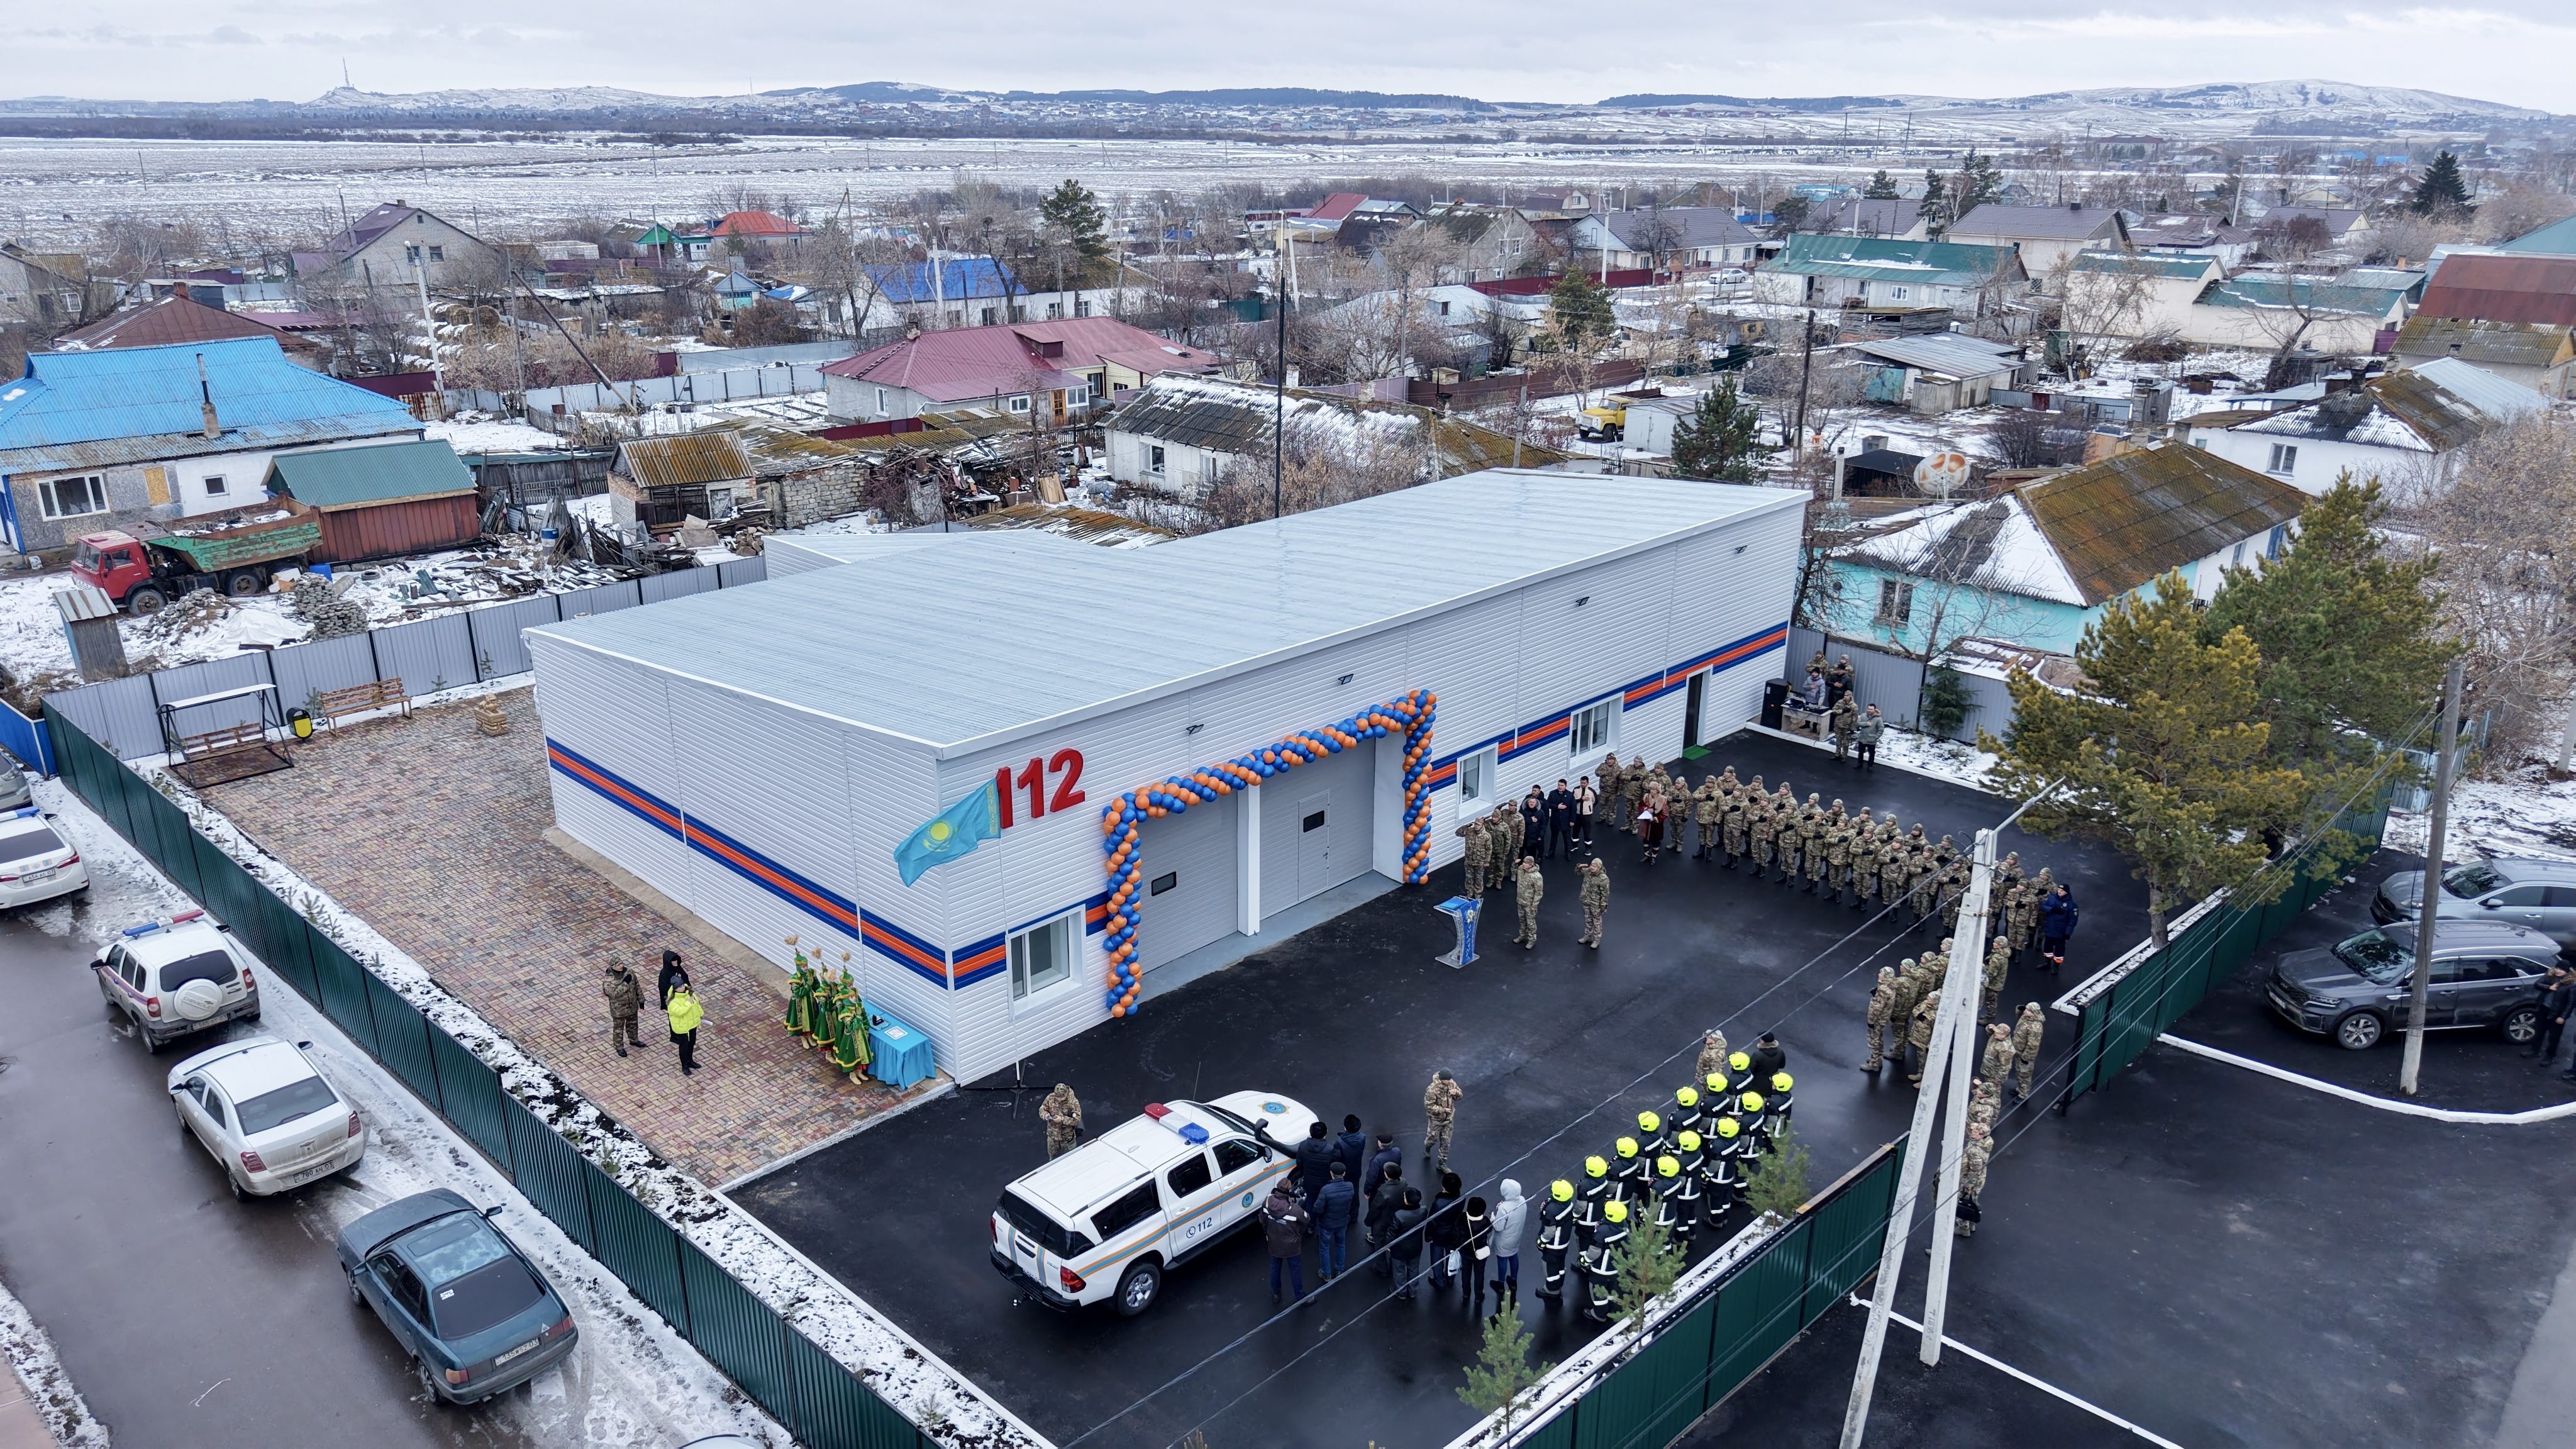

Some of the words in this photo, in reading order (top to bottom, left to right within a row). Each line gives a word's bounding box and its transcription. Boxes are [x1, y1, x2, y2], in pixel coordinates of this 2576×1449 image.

[996, 748, 1085, 829] 112
[1197, 1217, 1213, 1232] 112
[529, 1340, 538, 1348] 03
